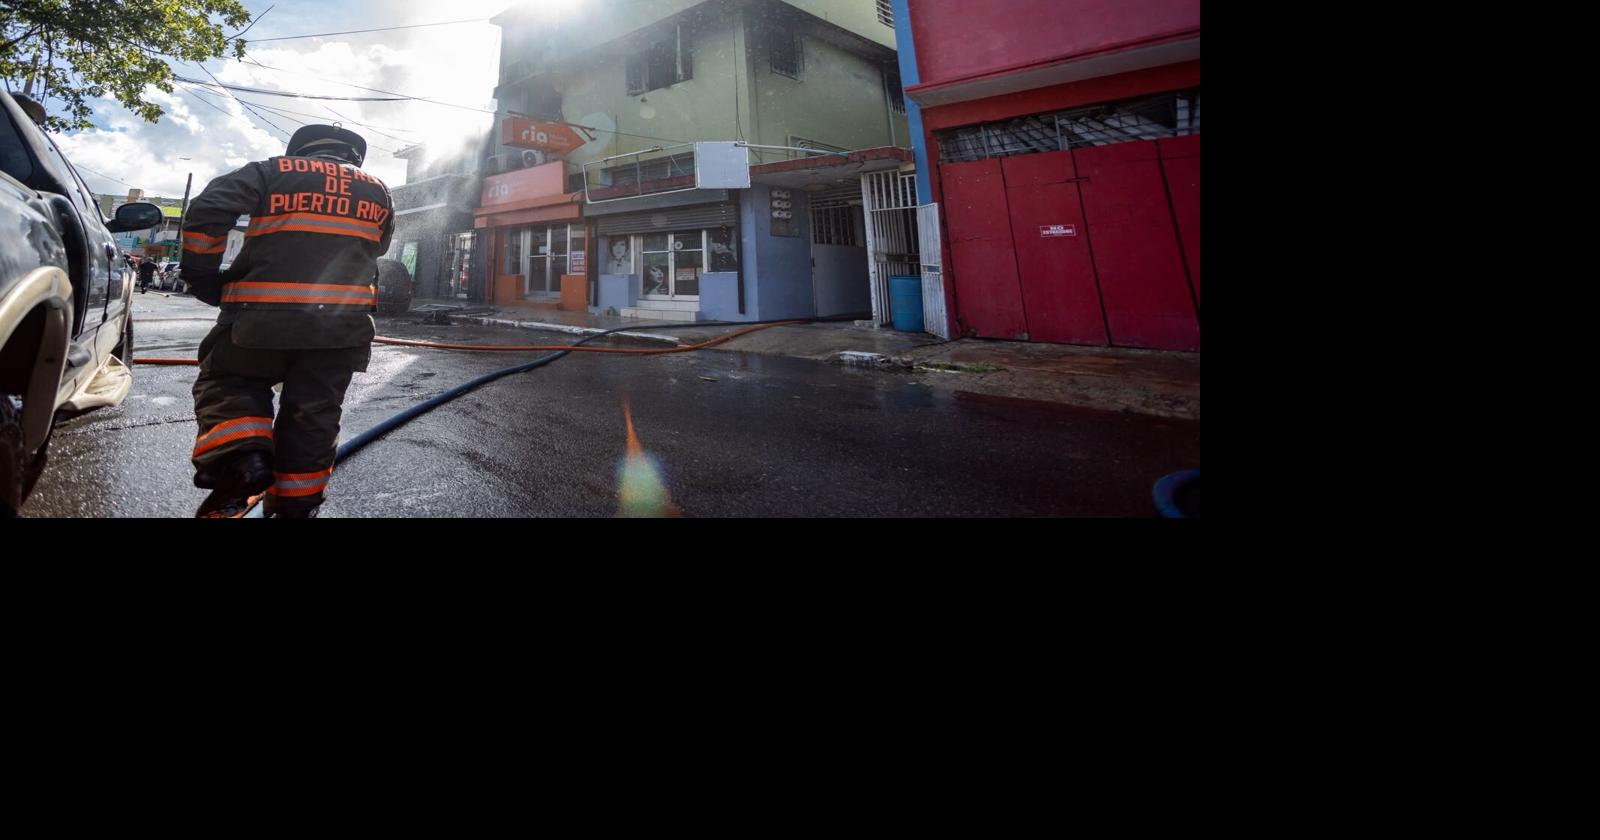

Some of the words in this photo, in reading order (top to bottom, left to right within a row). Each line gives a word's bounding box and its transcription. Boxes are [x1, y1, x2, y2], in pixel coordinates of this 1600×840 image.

[521, 125, 548, 144] ria
[325, 176, 352, 195] DE
[270, 193, 350, 214] PUERTO
